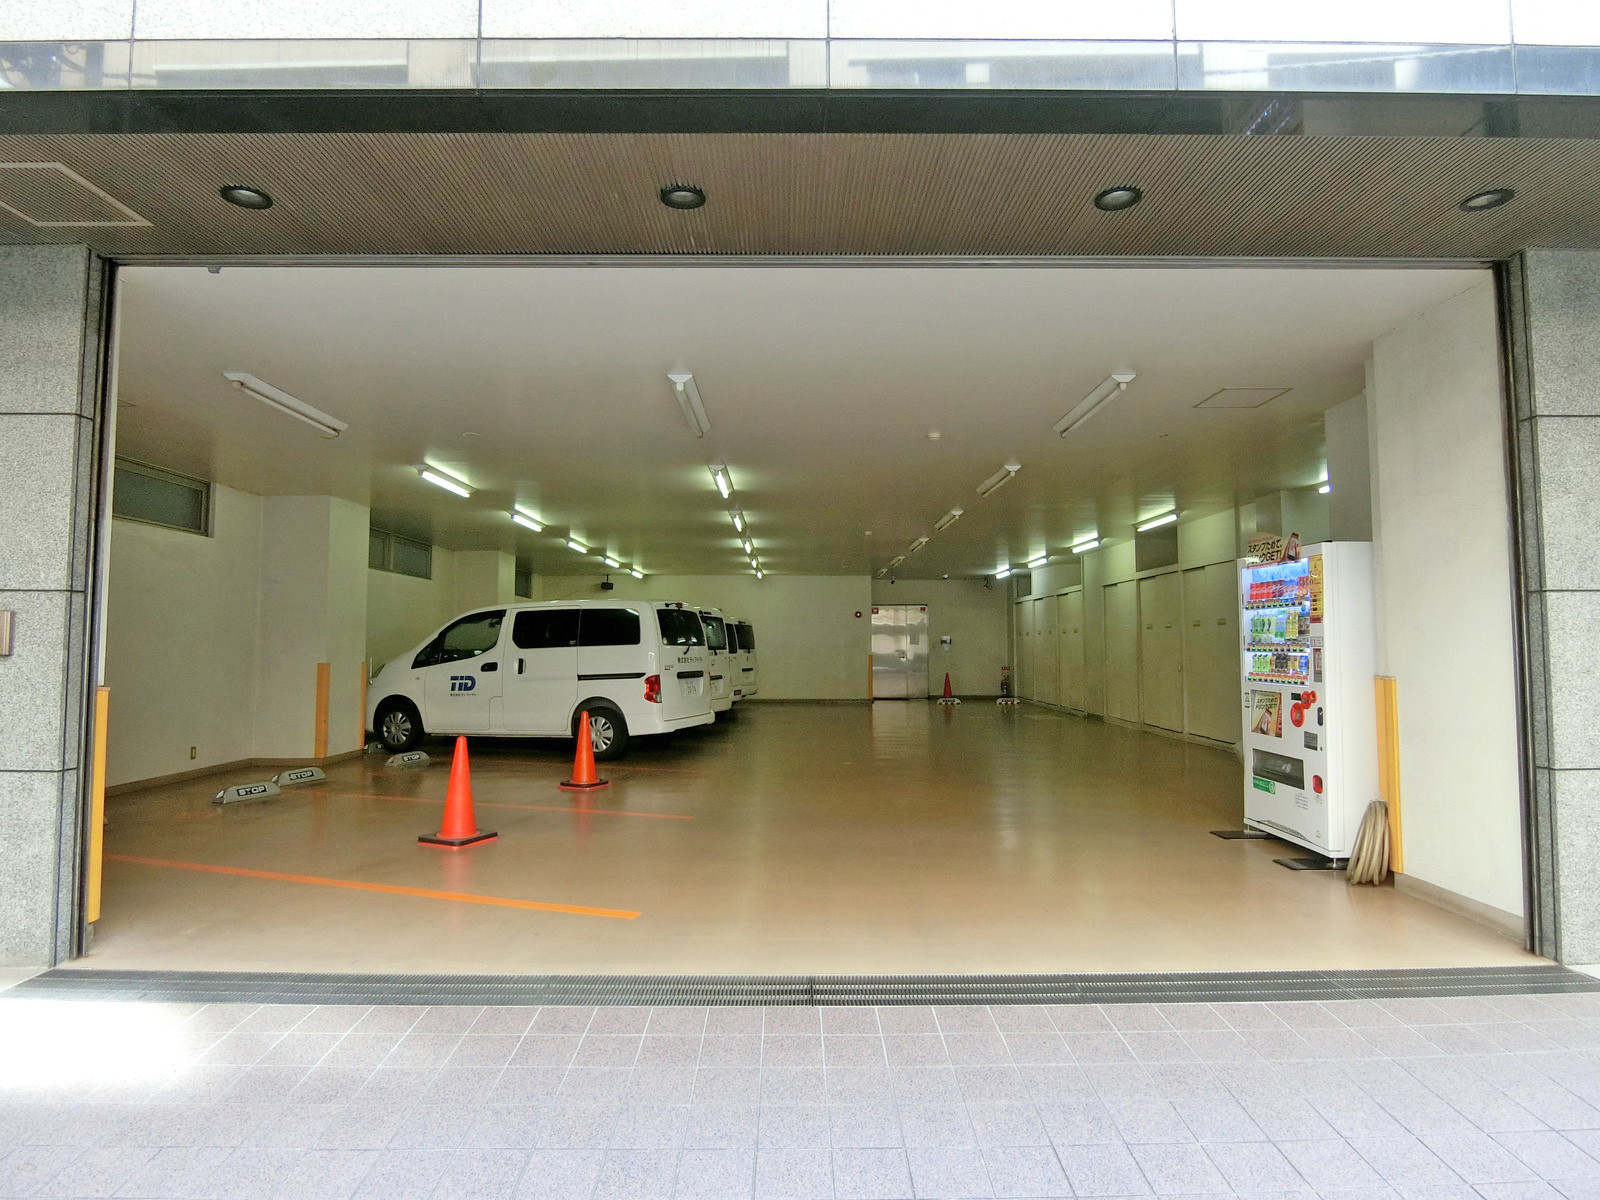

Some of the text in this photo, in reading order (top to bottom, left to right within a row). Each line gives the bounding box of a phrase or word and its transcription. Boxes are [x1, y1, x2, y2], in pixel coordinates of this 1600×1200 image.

[450, 675, 477, 692] TID
[290, 770, 313, 780] STOP
[238, 785, 265, 796] STOP
